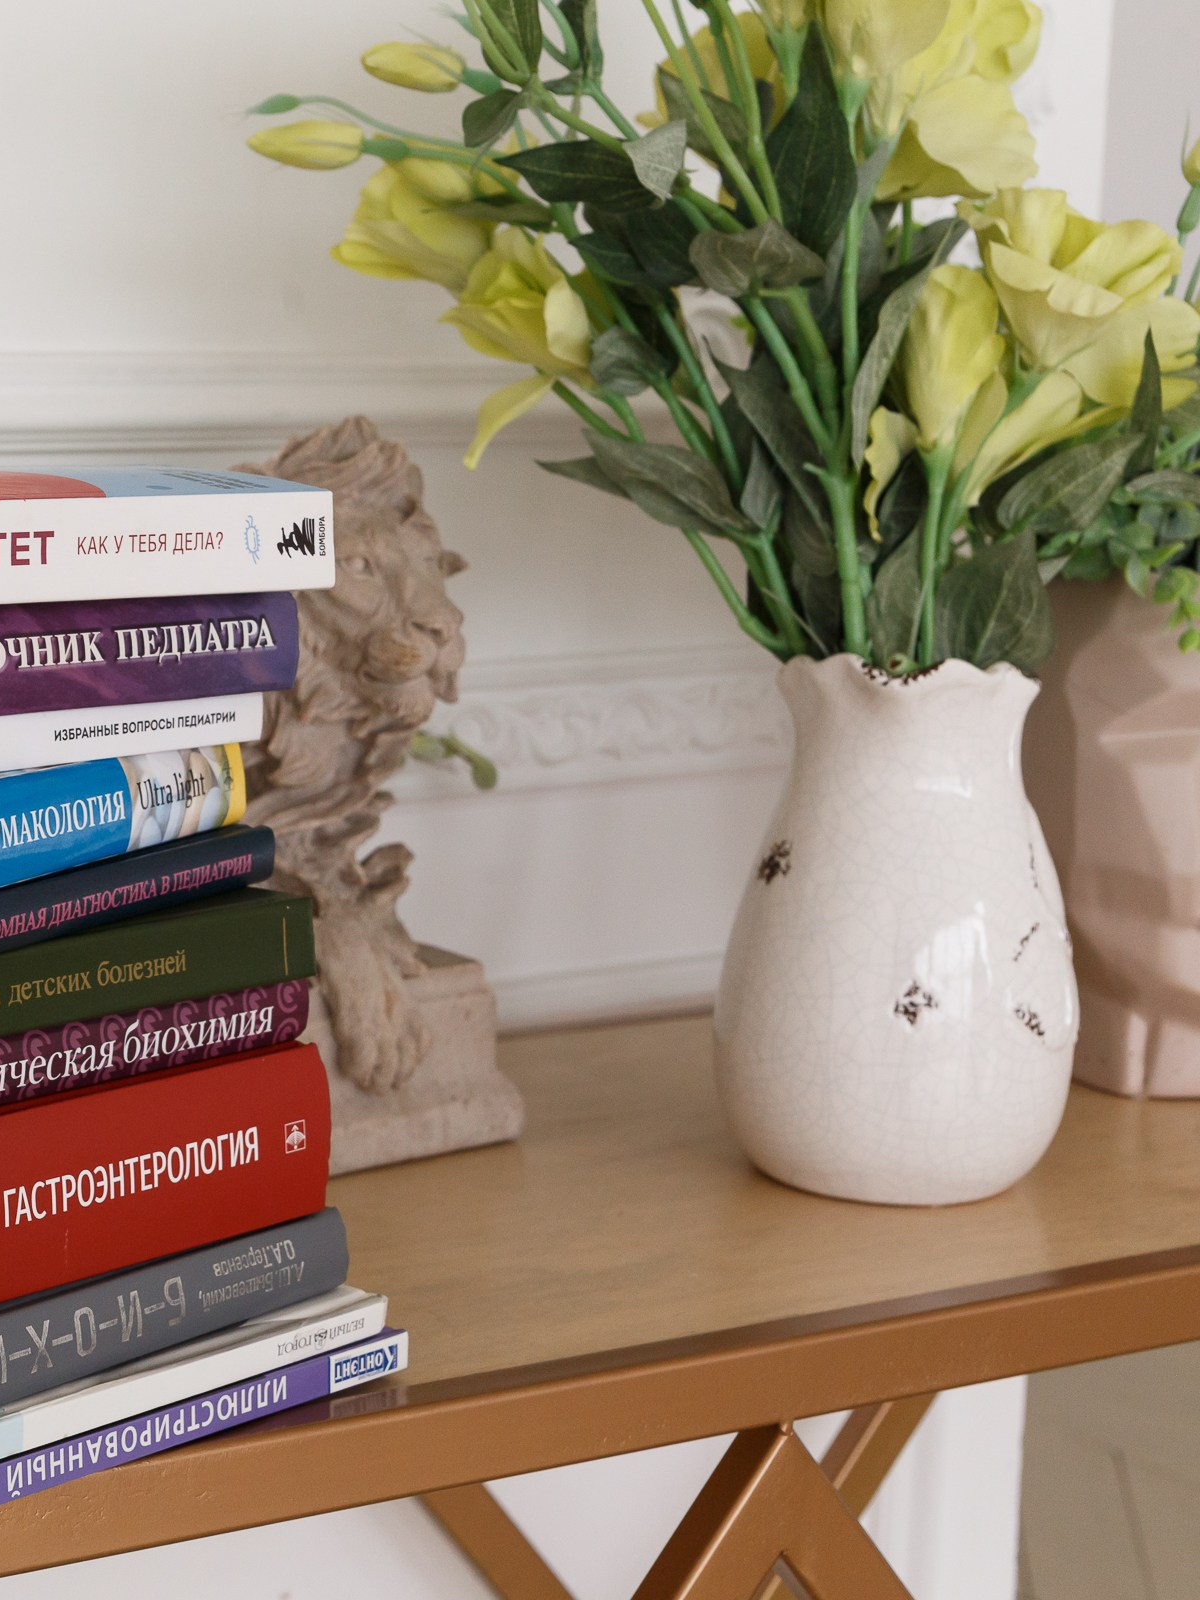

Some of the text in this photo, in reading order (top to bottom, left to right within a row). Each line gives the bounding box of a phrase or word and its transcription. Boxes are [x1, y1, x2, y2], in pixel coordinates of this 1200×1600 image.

[77, 535, 107, 556] КАК
[114, 534, 125, 555] У
[129, 533, 168, 554] ТЕБЯ
[172, 531, 224, 555] ДЕЛА?
[318, 516, 327, 557] БОМБОРА
[114, 617, 275, 667] ПЕДИАТРА
[54, 711, 236, 742] ИЗБРАННЫЕ ВОПРОСЫ ПЕДИАТРИИ
[136, 768, 206, 811] Ultra light
[48, 878, 157, 930] ДИАГНОСТИКА
[160, 875, 170, 896] В
[171, 853, 253, 892] ПЕДИАТРИИ
[8, 967, 91, 1008] детских
[96, 949, 187, 988] болезней
[122, 1005, 275, 1065] биохимия
[2, 1126, 260, 1228] ГАСТРОЭНТЕРОЛОГИЯ
[277, 1317, 365, 1357] БЕЛЫЙ ГОРОД
[6, 1374, 288, 1498] ИЛЛЮСТРИРОВАННЫЙ
